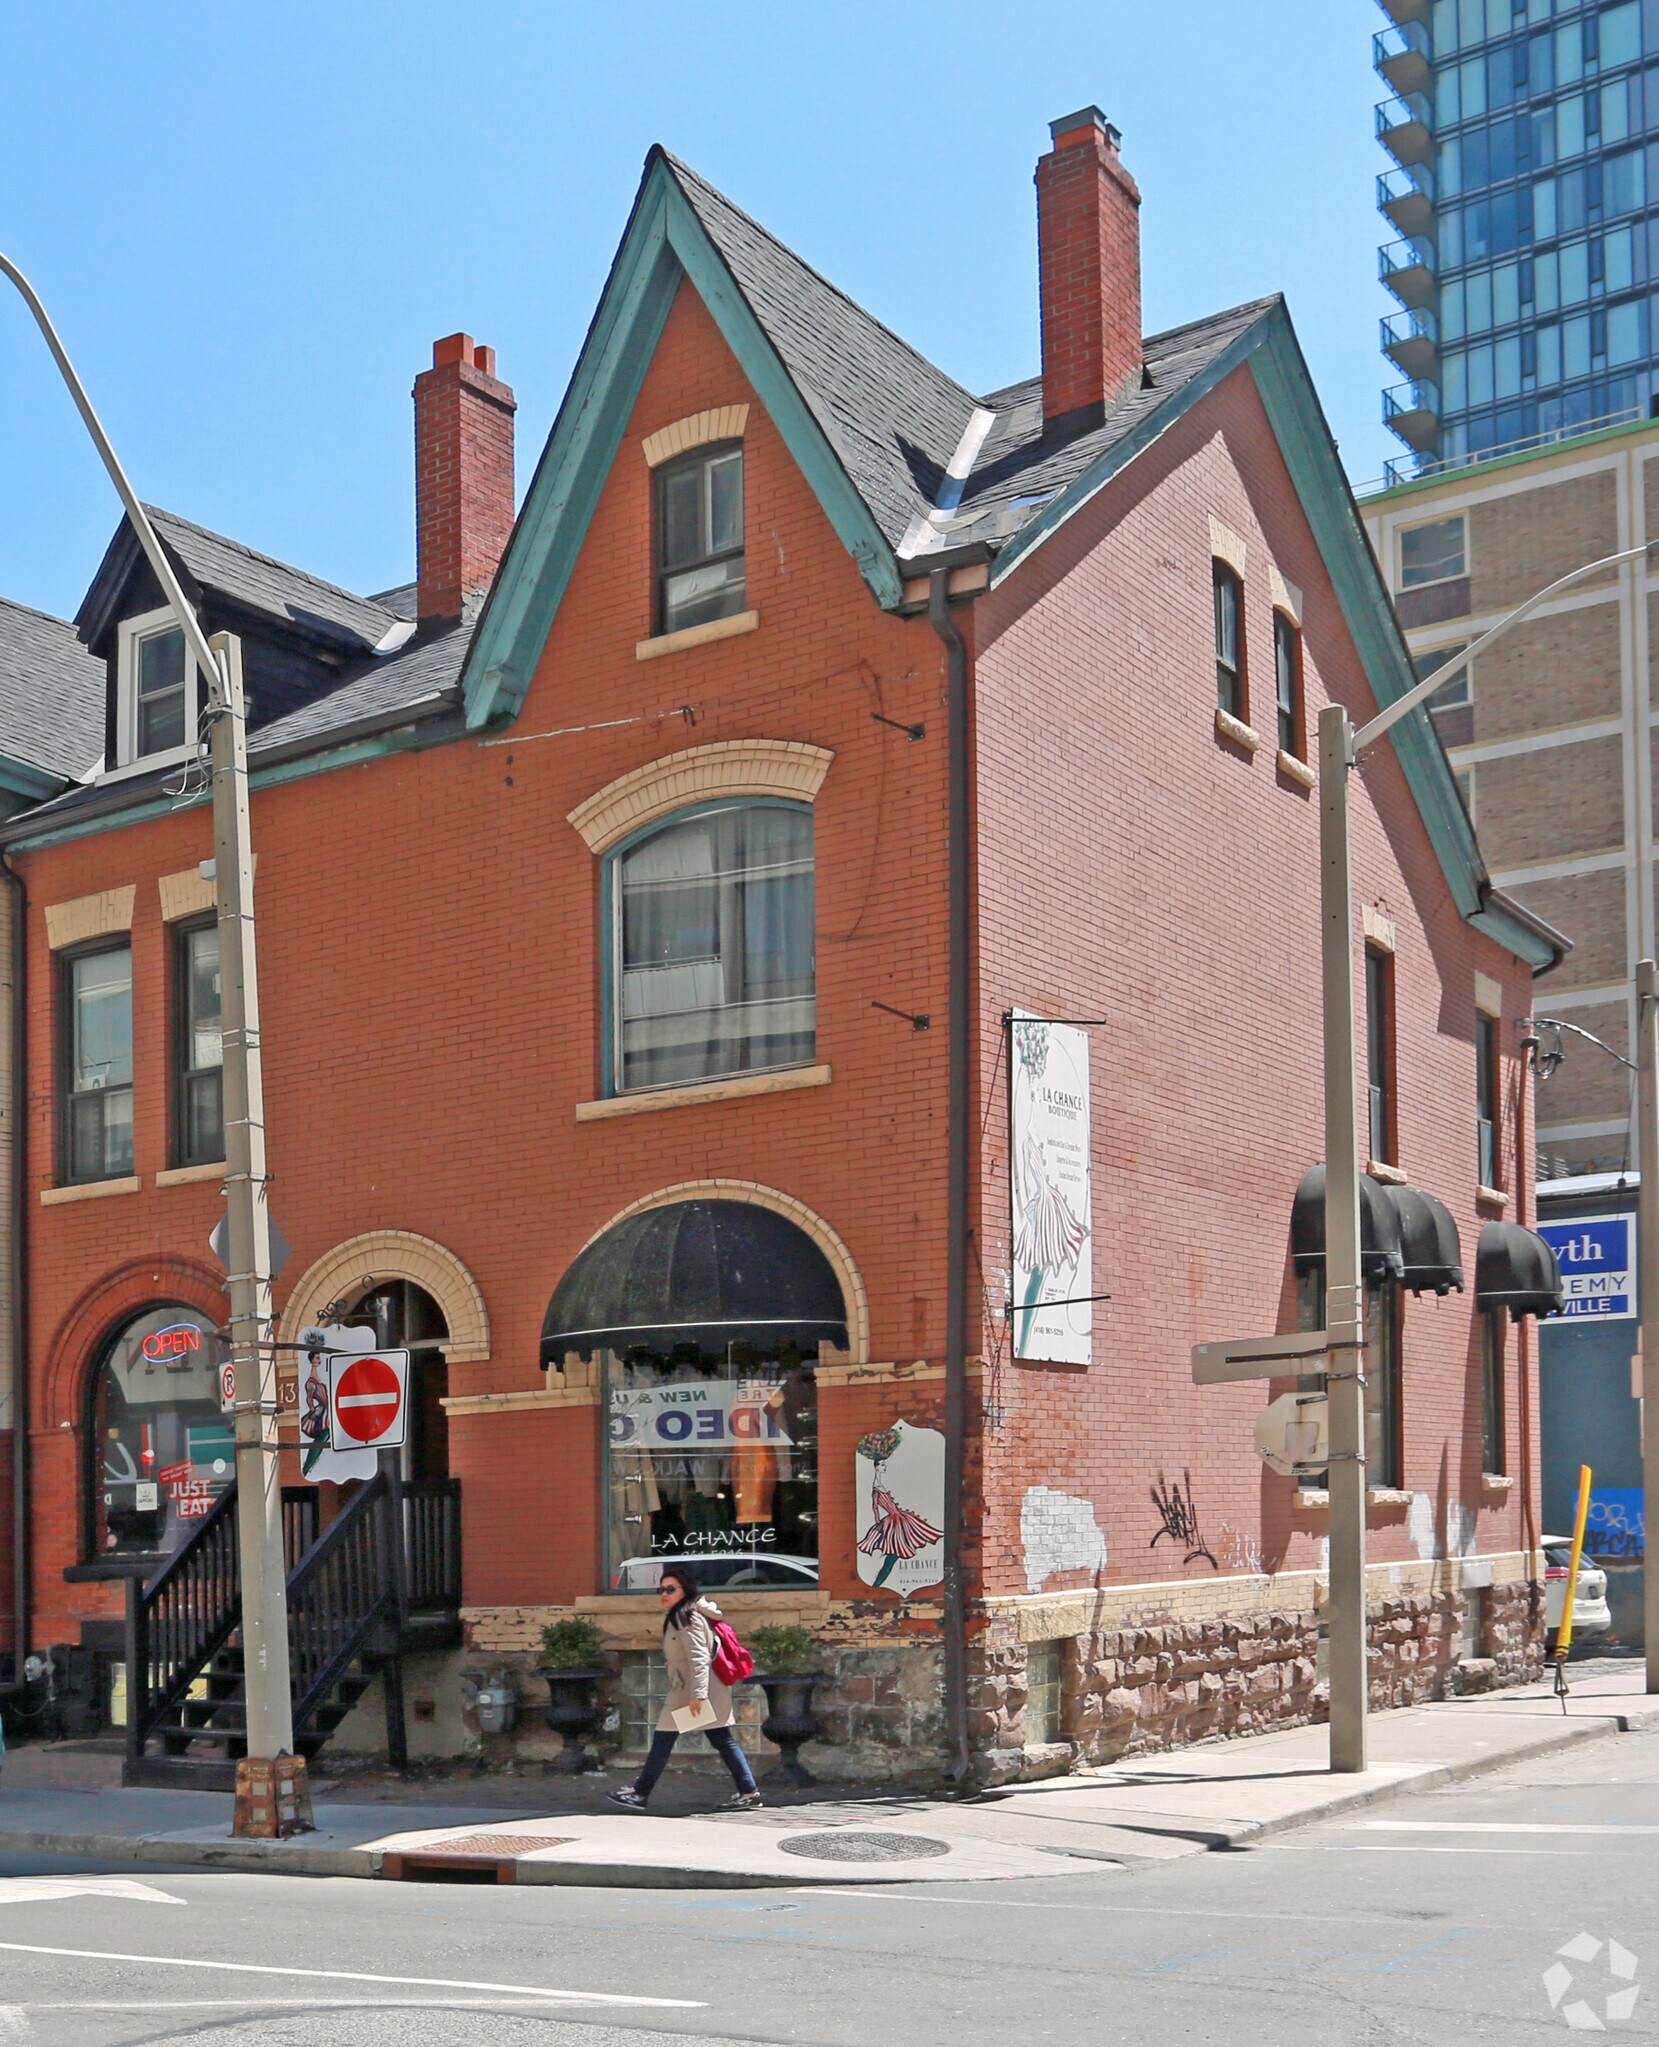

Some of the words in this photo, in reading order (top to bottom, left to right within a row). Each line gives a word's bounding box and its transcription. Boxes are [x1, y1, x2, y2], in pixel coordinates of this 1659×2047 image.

[1043, 1087, 1052, 1103] LA
[1053, 1090, 1082, 1111] CHANCE
[142, 1329, 200, 1357] OPEN
[278, 1383, 297, 1404] 13
[169, 1479, 211, 1498] JUST
[180, 1498, 212, 1515] EAT
[650, 1533, 679, 1549] LA
[683, 1527, 778, 1546] CHANCE
[911, 1559, 938, 1569] CHANCE
